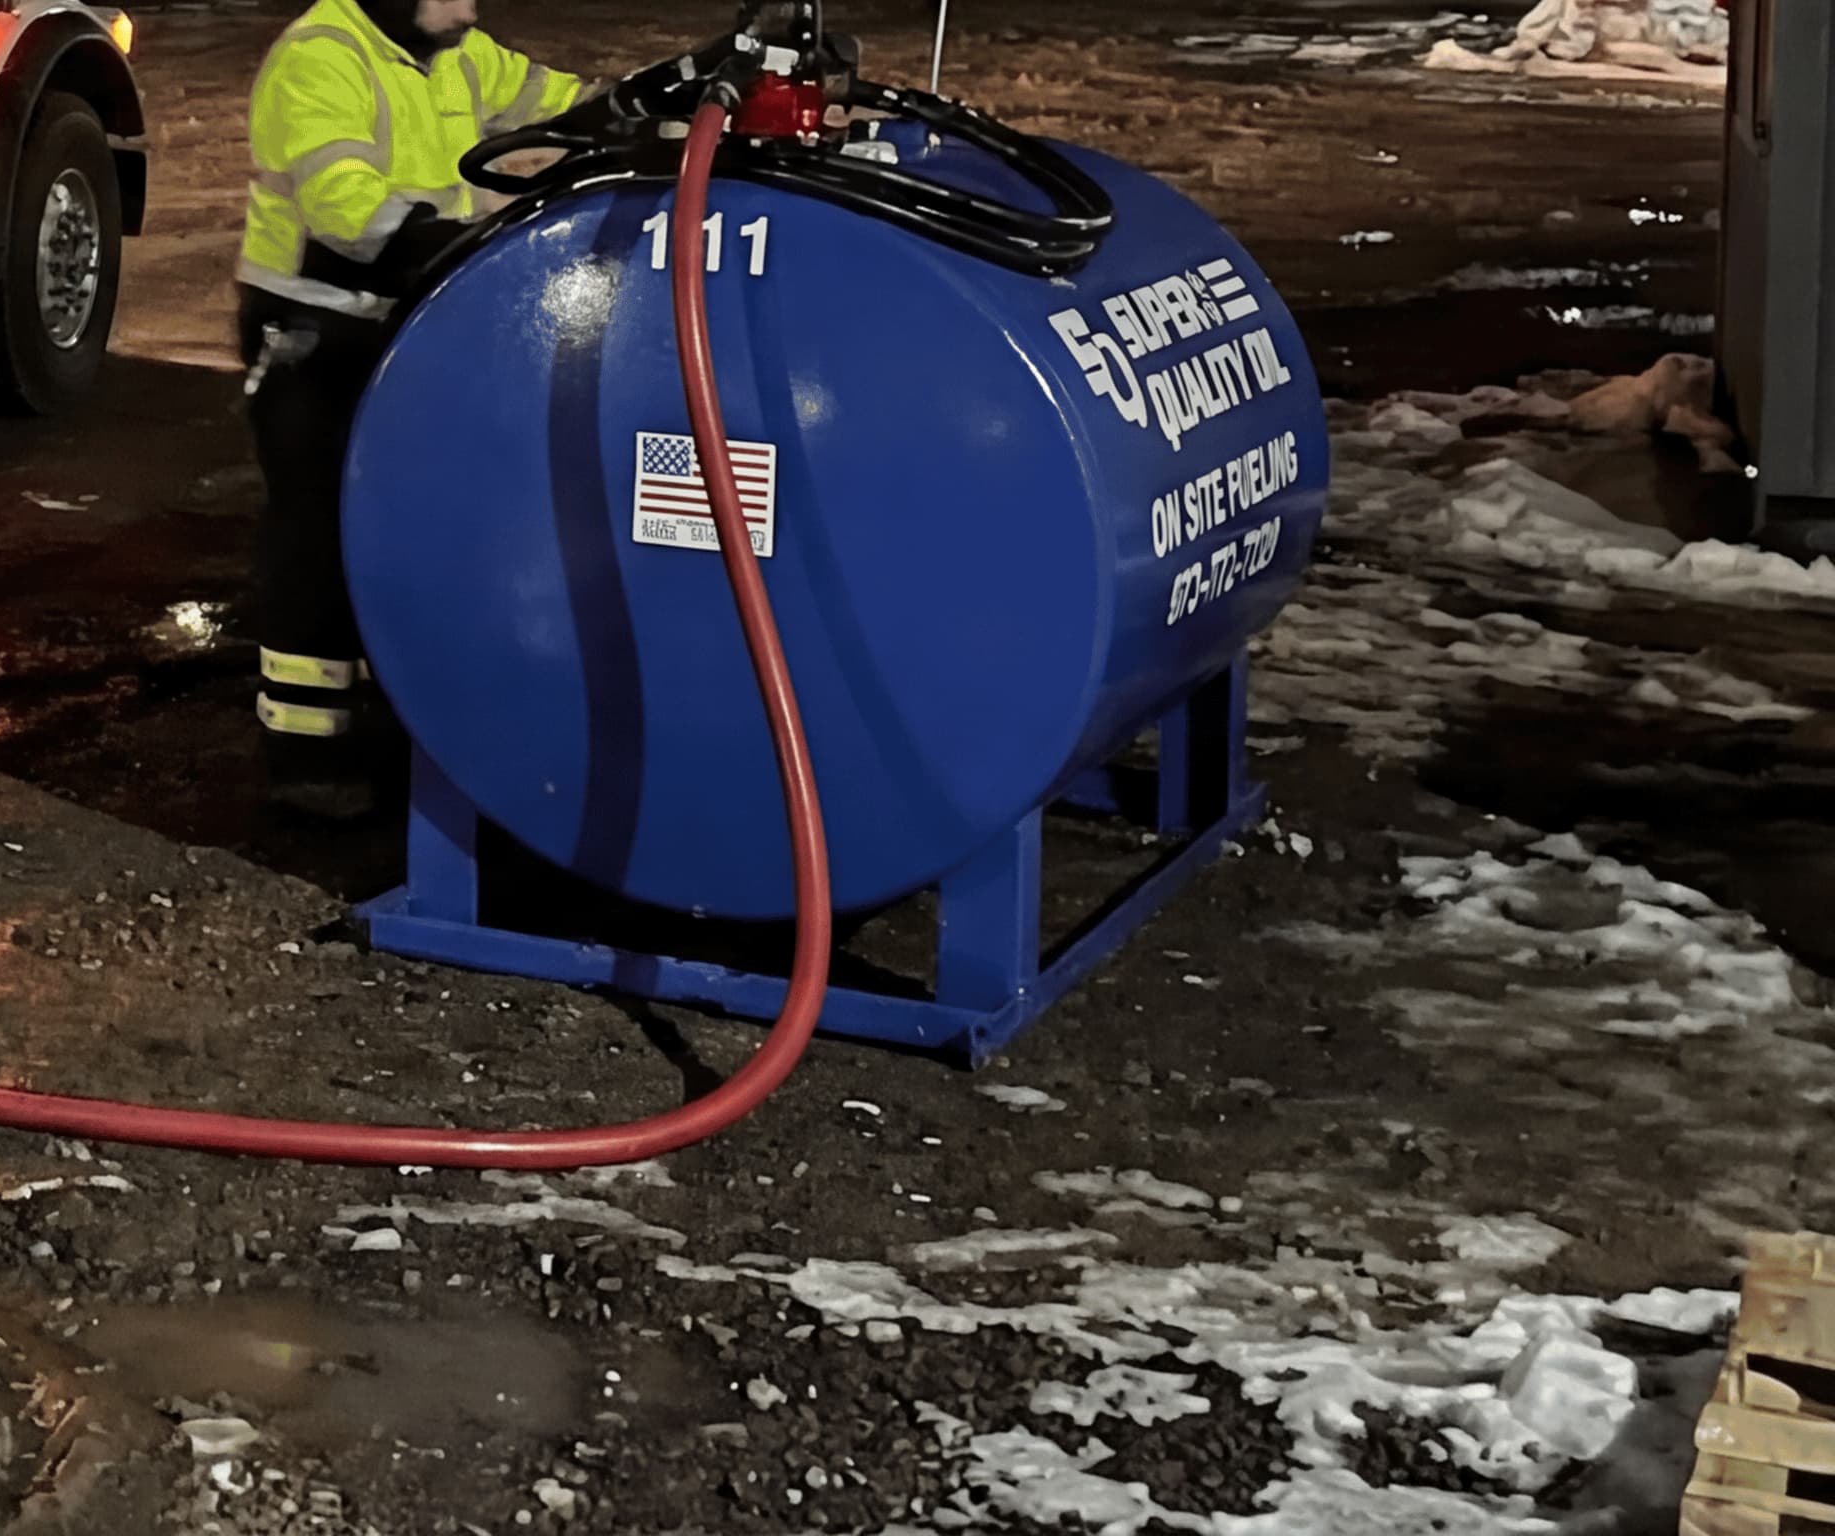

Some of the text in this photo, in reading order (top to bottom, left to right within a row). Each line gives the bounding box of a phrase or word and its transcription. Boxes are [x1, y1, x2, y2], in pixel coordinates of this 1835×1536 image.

[642, 210, 769, 276] 111
[1101, 274, 1212, 359] SUPER
[1146, 327, 1292, 453] QUALITY OIL
[1151, 489, 1182, 559] ON
[1183, 467, 1227, 542] SITE
